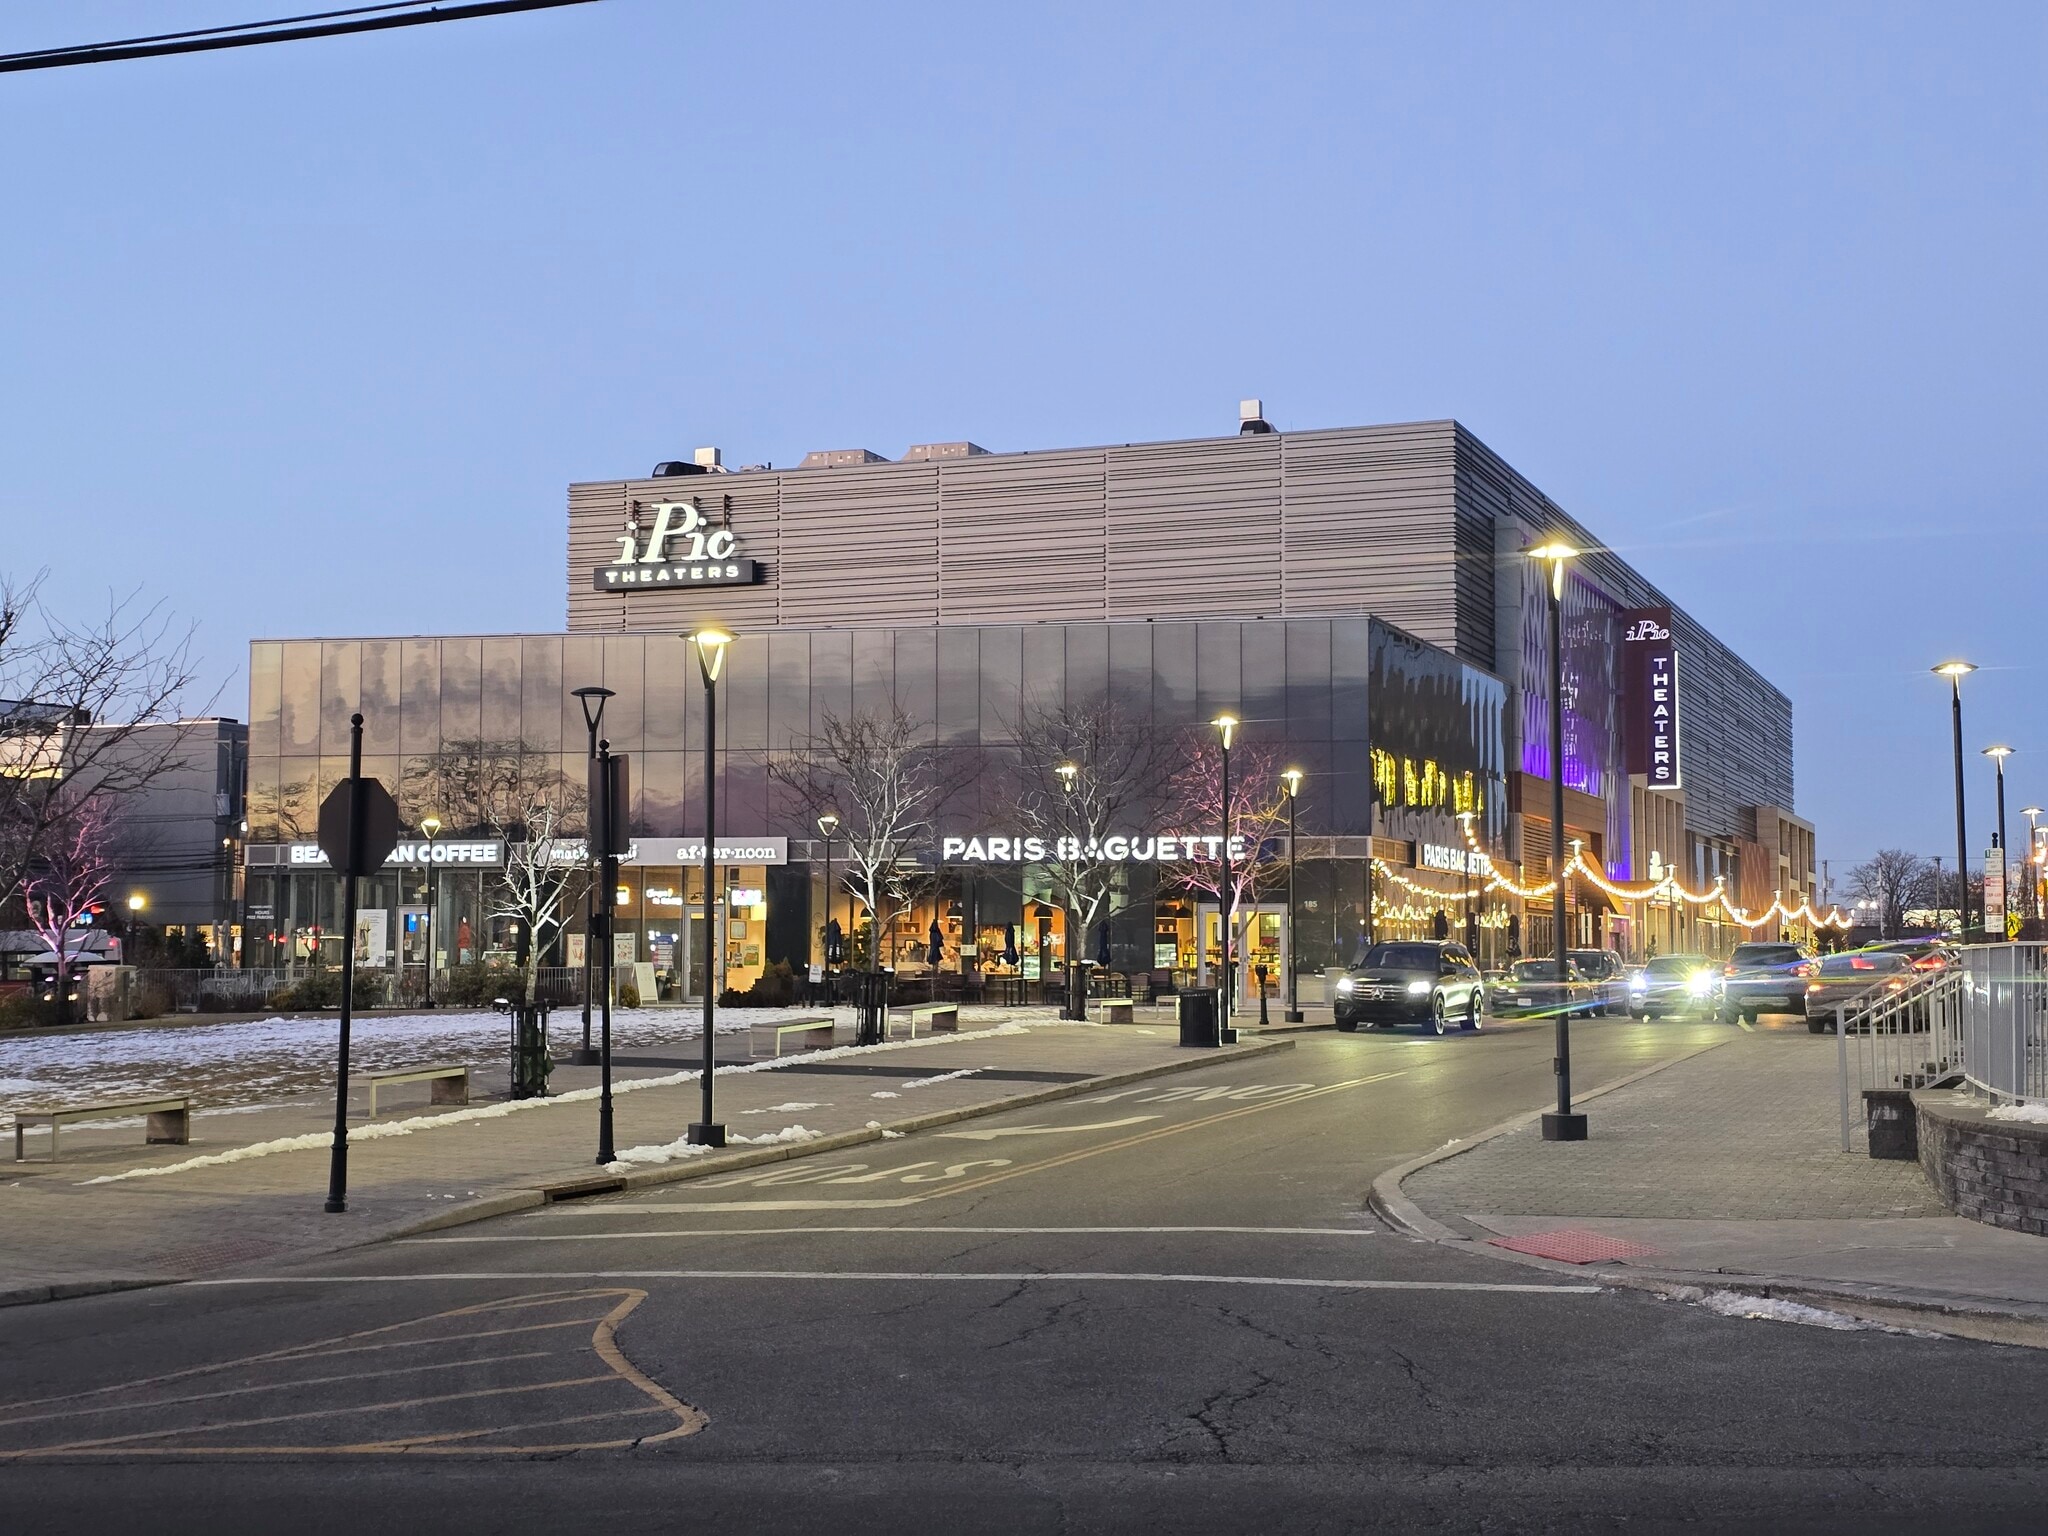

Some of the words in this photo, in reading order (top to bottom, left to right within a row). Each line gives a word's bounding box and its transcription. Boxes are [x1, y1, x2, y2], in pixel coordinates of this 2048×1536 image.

[611, 502, 736, 564] iPic
[605, 565, 739, 584] THEATERS
[1625, 619, 1670, 641] iPic
[1652, 657, 1670, 780] THEATERS
[417, 844, 498, 862] COFFEE
[943, 836, 1046, 861] PARIS
[1057, 835, 1246, 861] BAGUETTE
[1423, 843, 1450, 870] PARIS
[677, 1158, 1013, 1189] STOP
